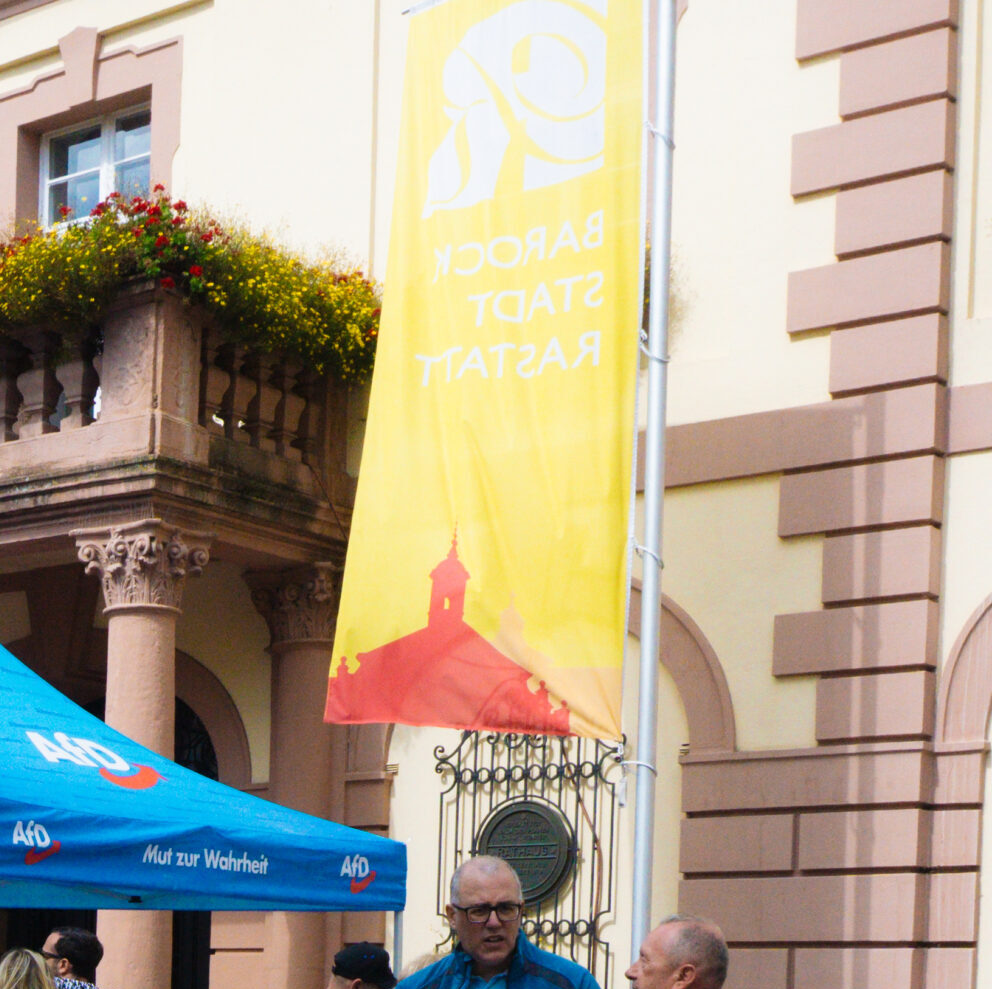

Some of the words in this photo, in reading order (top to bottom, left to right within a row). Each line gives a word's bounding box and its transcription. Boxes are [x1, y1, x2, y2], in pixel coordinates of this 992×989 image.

[25, 730, 130, 771] AfD
[12, 820, 51, 848] AfD
[142, 844, 172, 865] Mut
[175, 850, 200, 869] zur
[203, 848, 269, 875] Wahrheit
[339, 854, 370, 878] AfD
